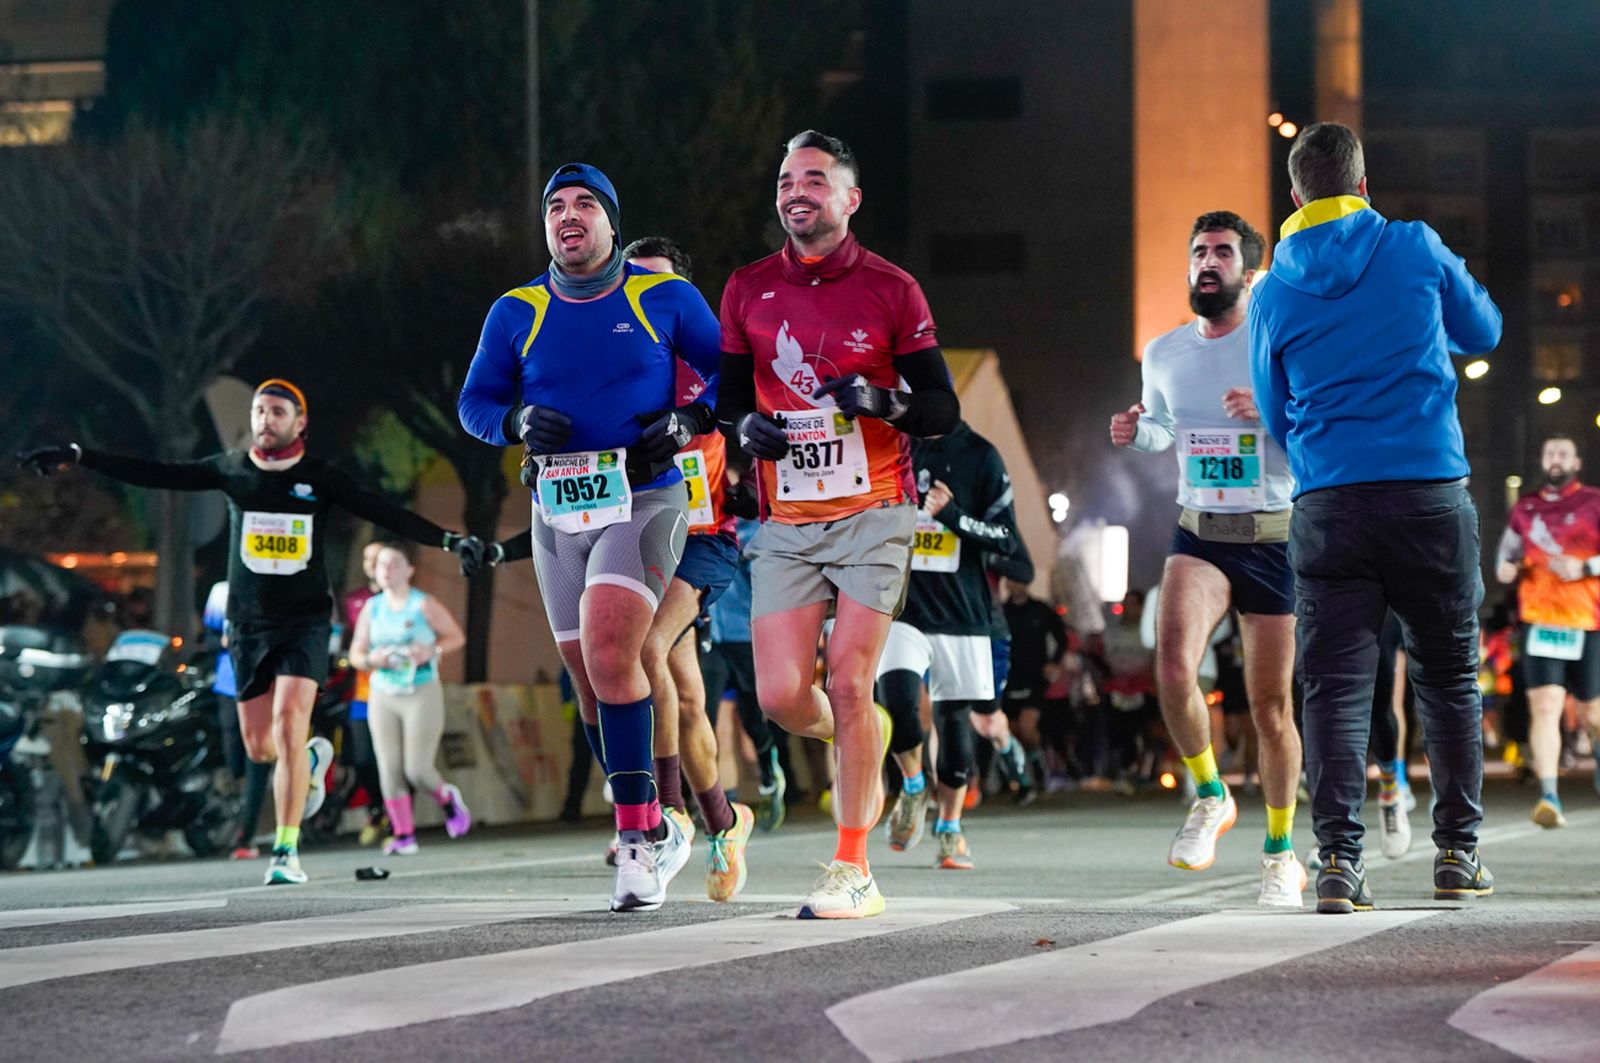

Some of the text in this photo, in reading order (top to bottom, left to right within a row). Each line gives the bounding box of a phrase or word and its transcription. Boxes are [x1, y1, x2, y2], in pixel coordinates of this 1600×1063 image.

[790, 370, 814, 395] 43
[788, 421, 812, 430] NOCHE
[813, 418, 825, 429] DE
[553, 457, 590, 467] NOCHE DE
[790, 438, 844, 470] 5377
[1199, 456, 1244, 480] 1218
[551, 473, 611, 505] 7952
[254, 534, 298, 554] 3408
